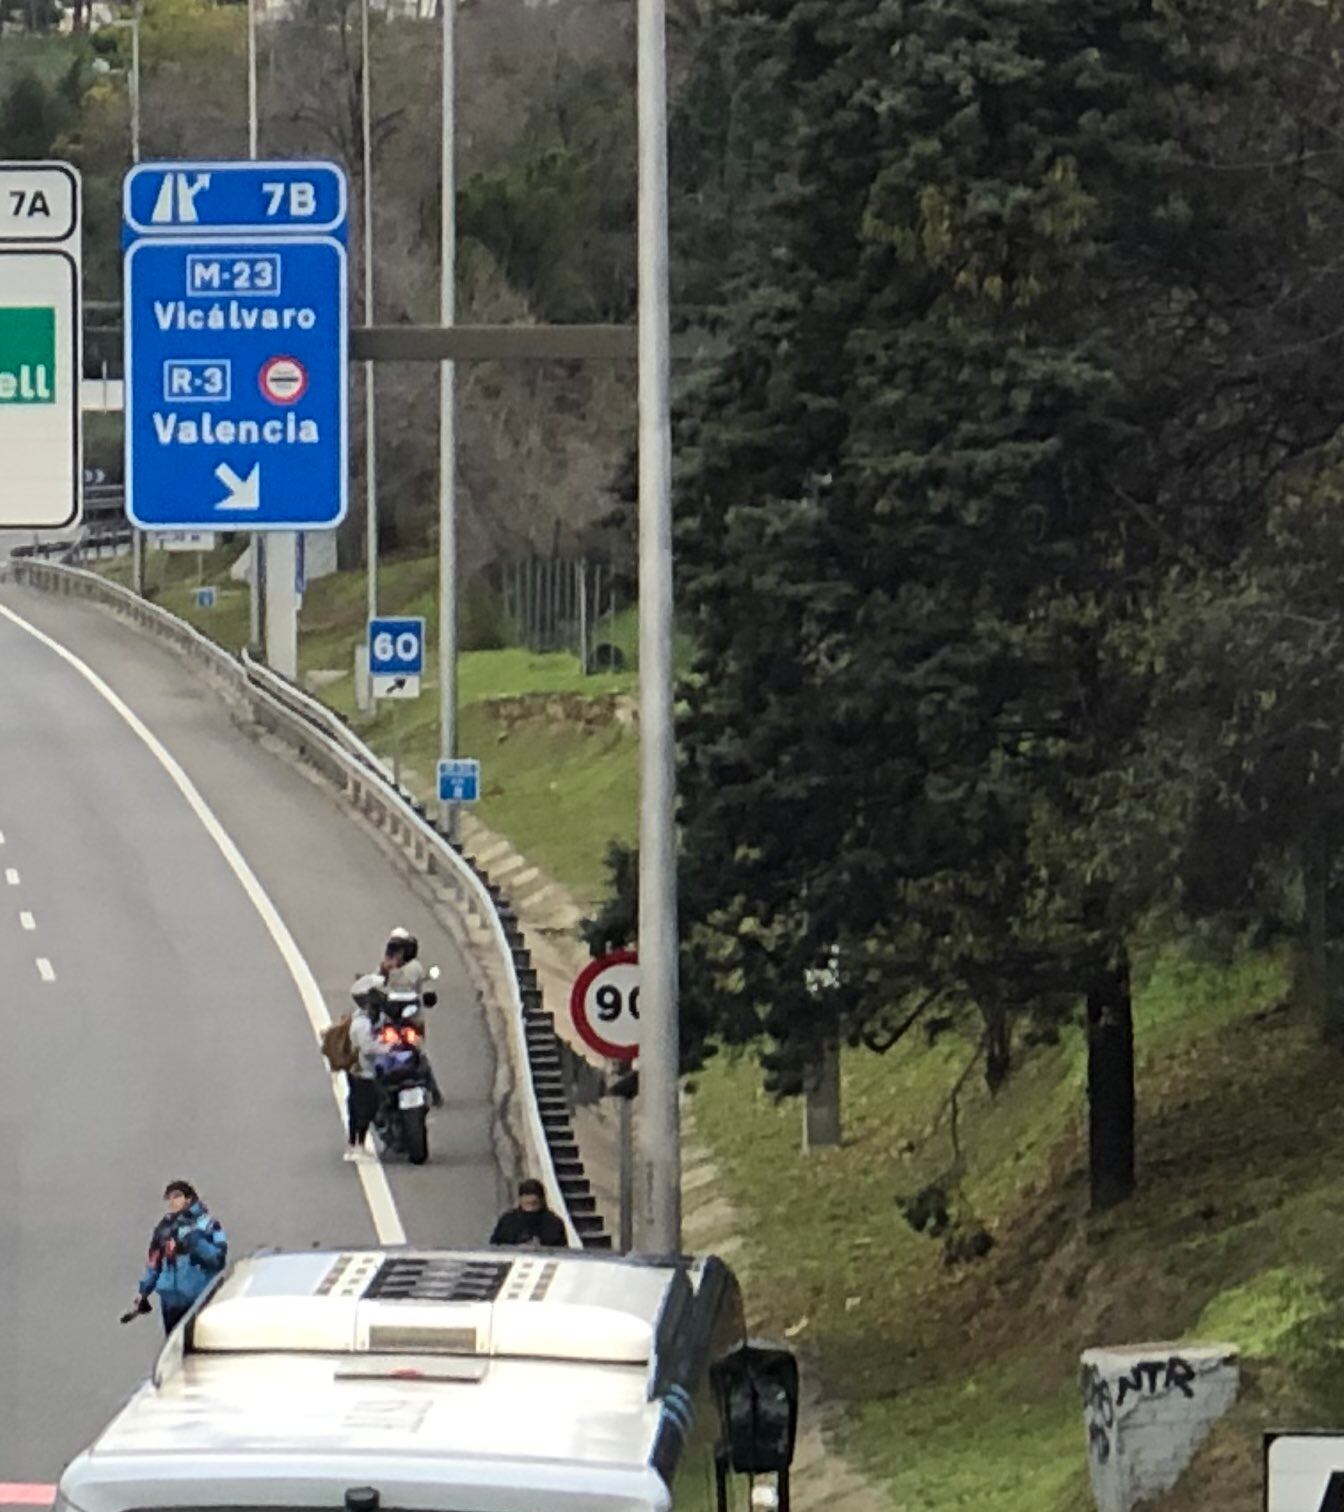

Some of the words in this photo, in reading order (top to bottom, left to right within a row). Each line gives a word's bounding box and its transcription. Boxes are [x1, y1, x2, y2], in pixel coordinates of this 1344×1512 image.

[9, 190, 51, 218] 7A
[262, 182, 318, 217] 7B
[193, 261, 274, 290] M-23
[153, 300, 317, 331] Vicálvaro
[170, 367, 224, 394] R-3
[152, 412, 320, 445] Valencia
[373, 633, 420, 661] 60
